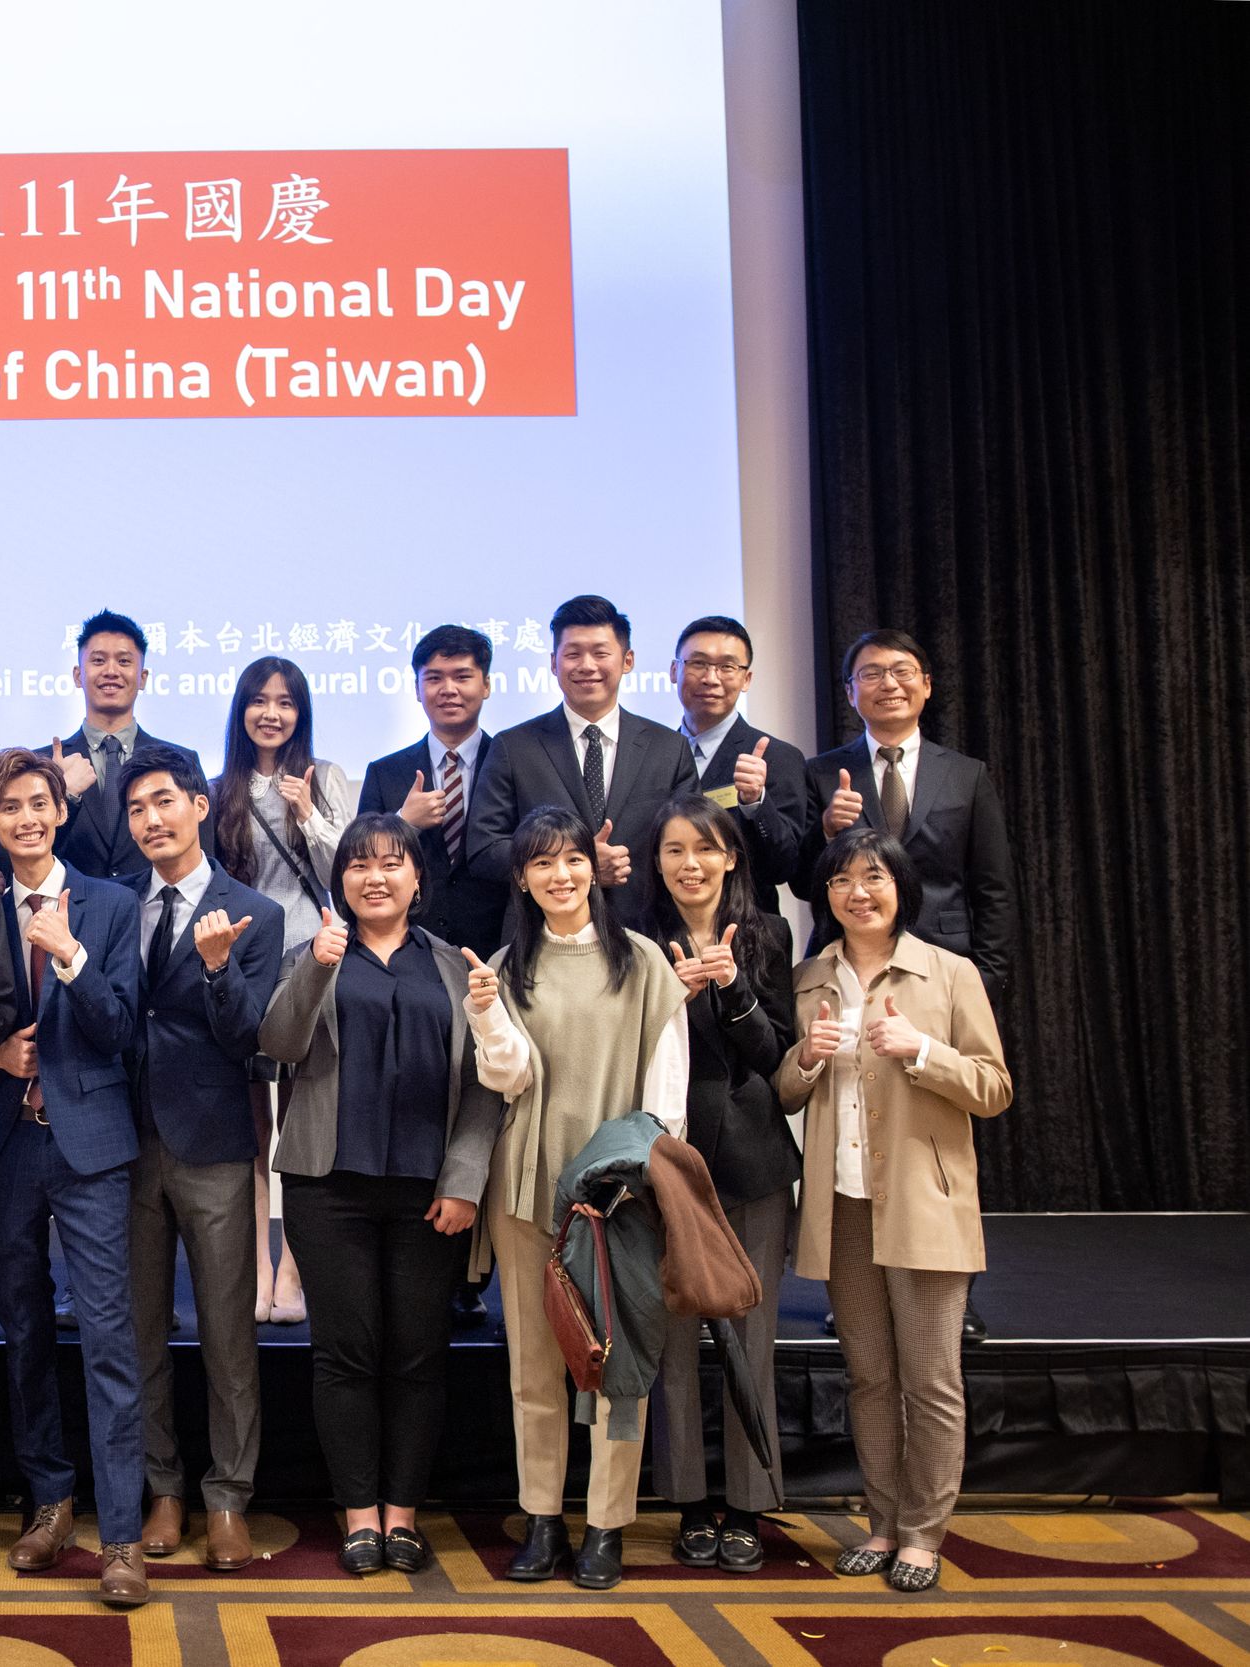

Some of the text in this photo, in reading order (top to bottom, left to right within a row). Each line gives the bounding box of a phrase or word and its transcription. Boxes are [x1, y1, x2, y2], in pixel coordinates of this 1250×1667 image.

[17, 267, 120, 320] 111th
[145, 268, 393, 318] National
[416, 268, 525, 330] Day
[46, 350, 210, 400] China
[235, 343, 486, 407] (Taiwan)
[22, 668, 170, 697] Ecoic
[179, 665, 236, 695] and
